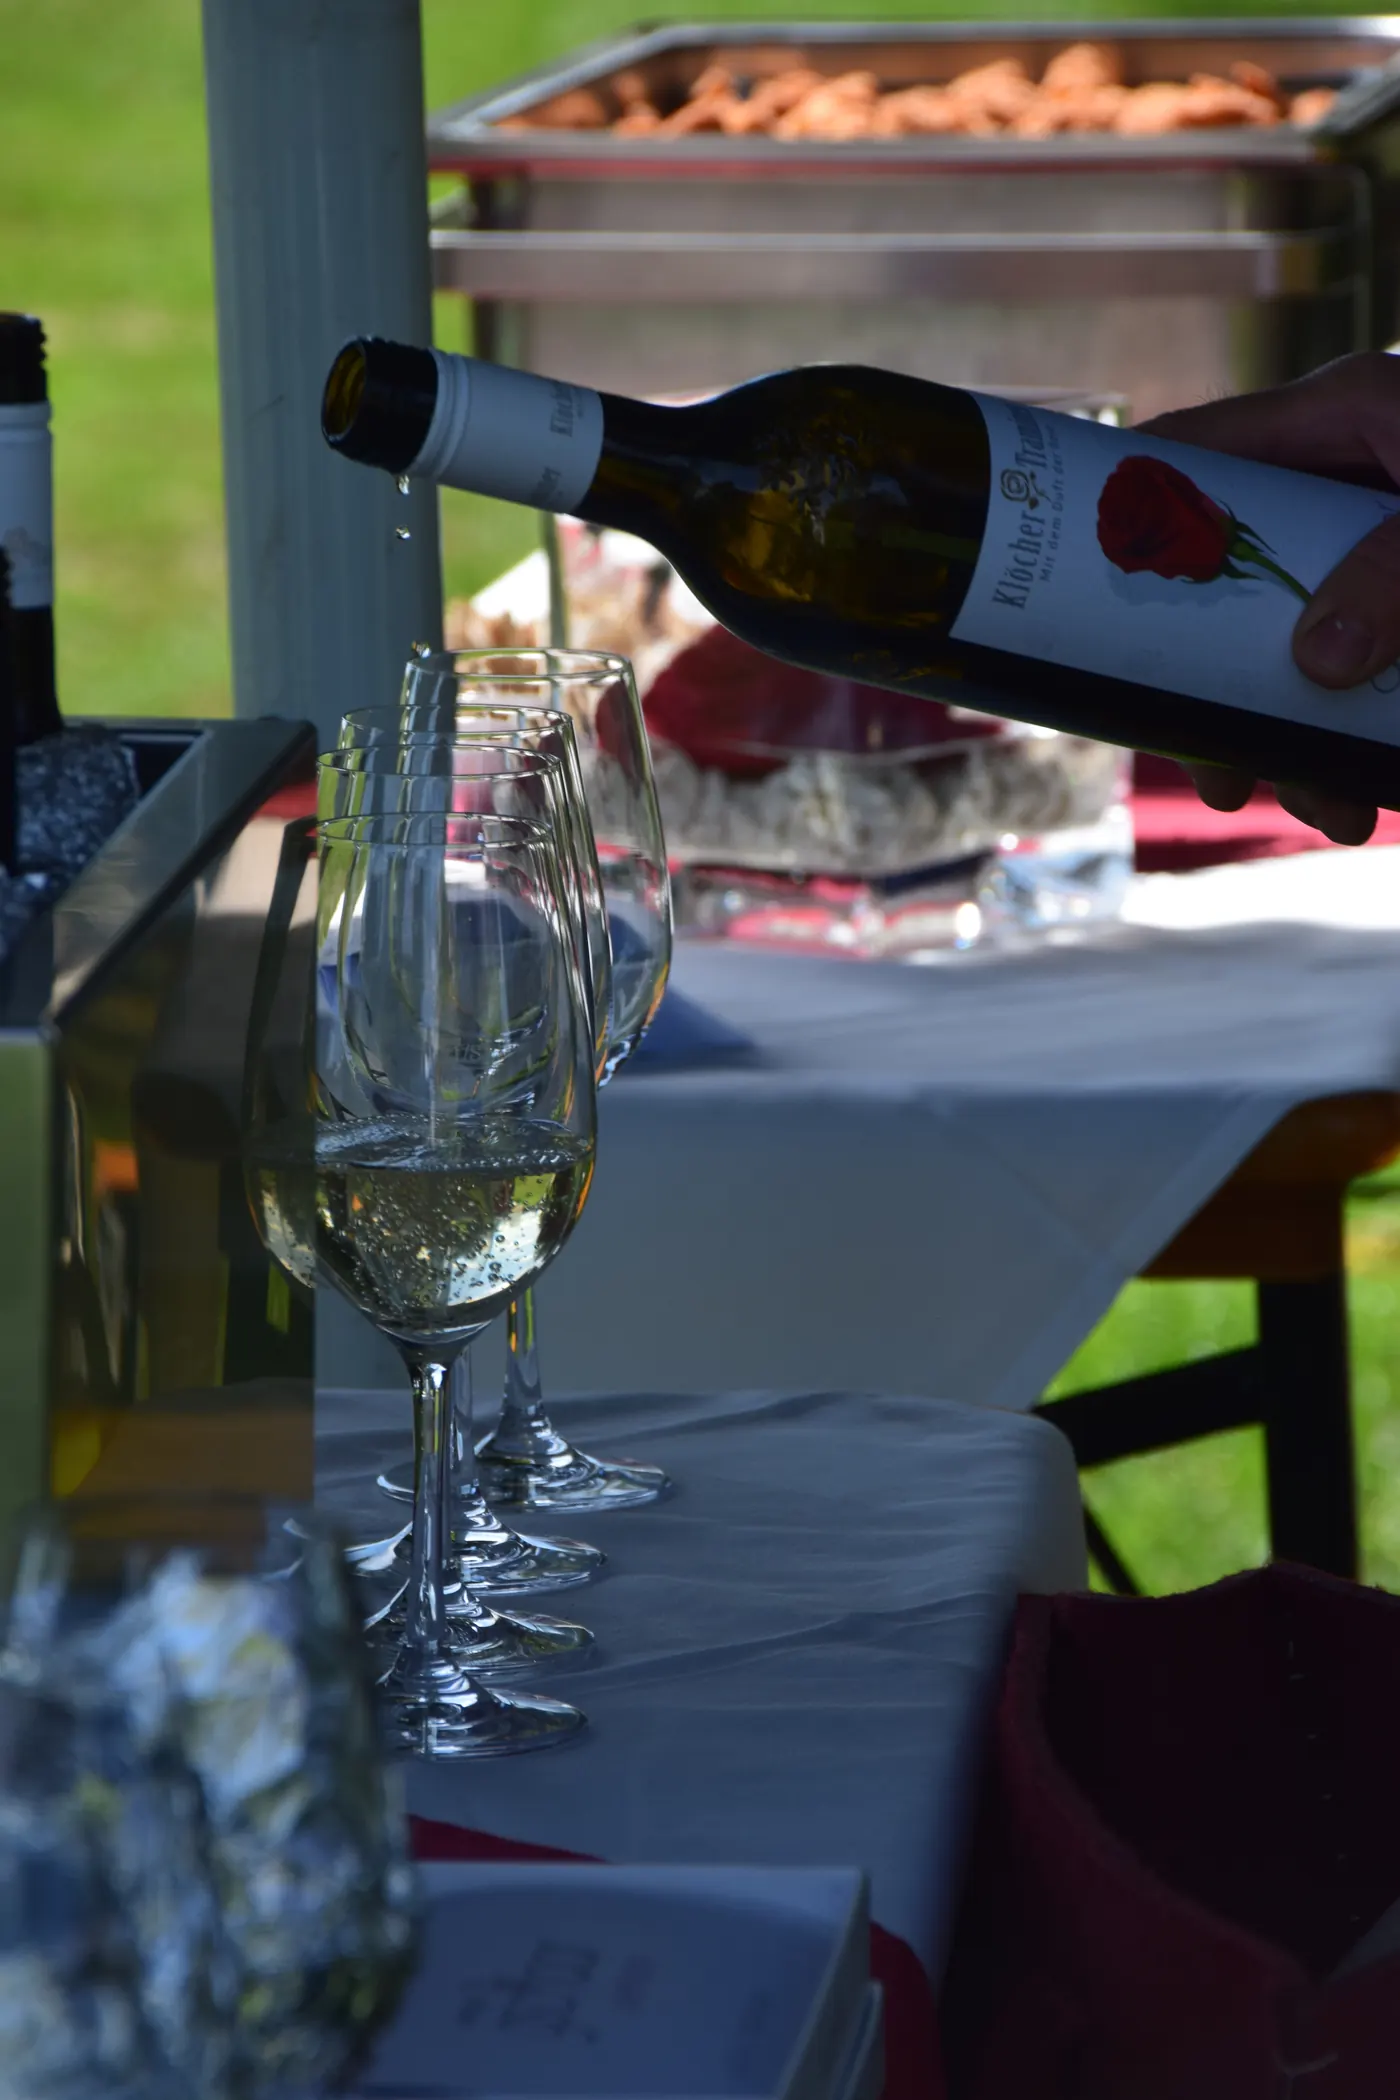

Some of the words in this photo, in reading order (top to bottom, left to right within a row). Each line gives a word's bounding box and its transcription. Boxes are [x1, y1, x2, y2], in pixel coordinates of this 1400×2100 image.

[1052, 480, 1065, 512] Duft
[1047, 517, 1062, 550] dem
[992, 511, 1045, 609] Klöcher
[1039, 556, 1056, 582] Mit
